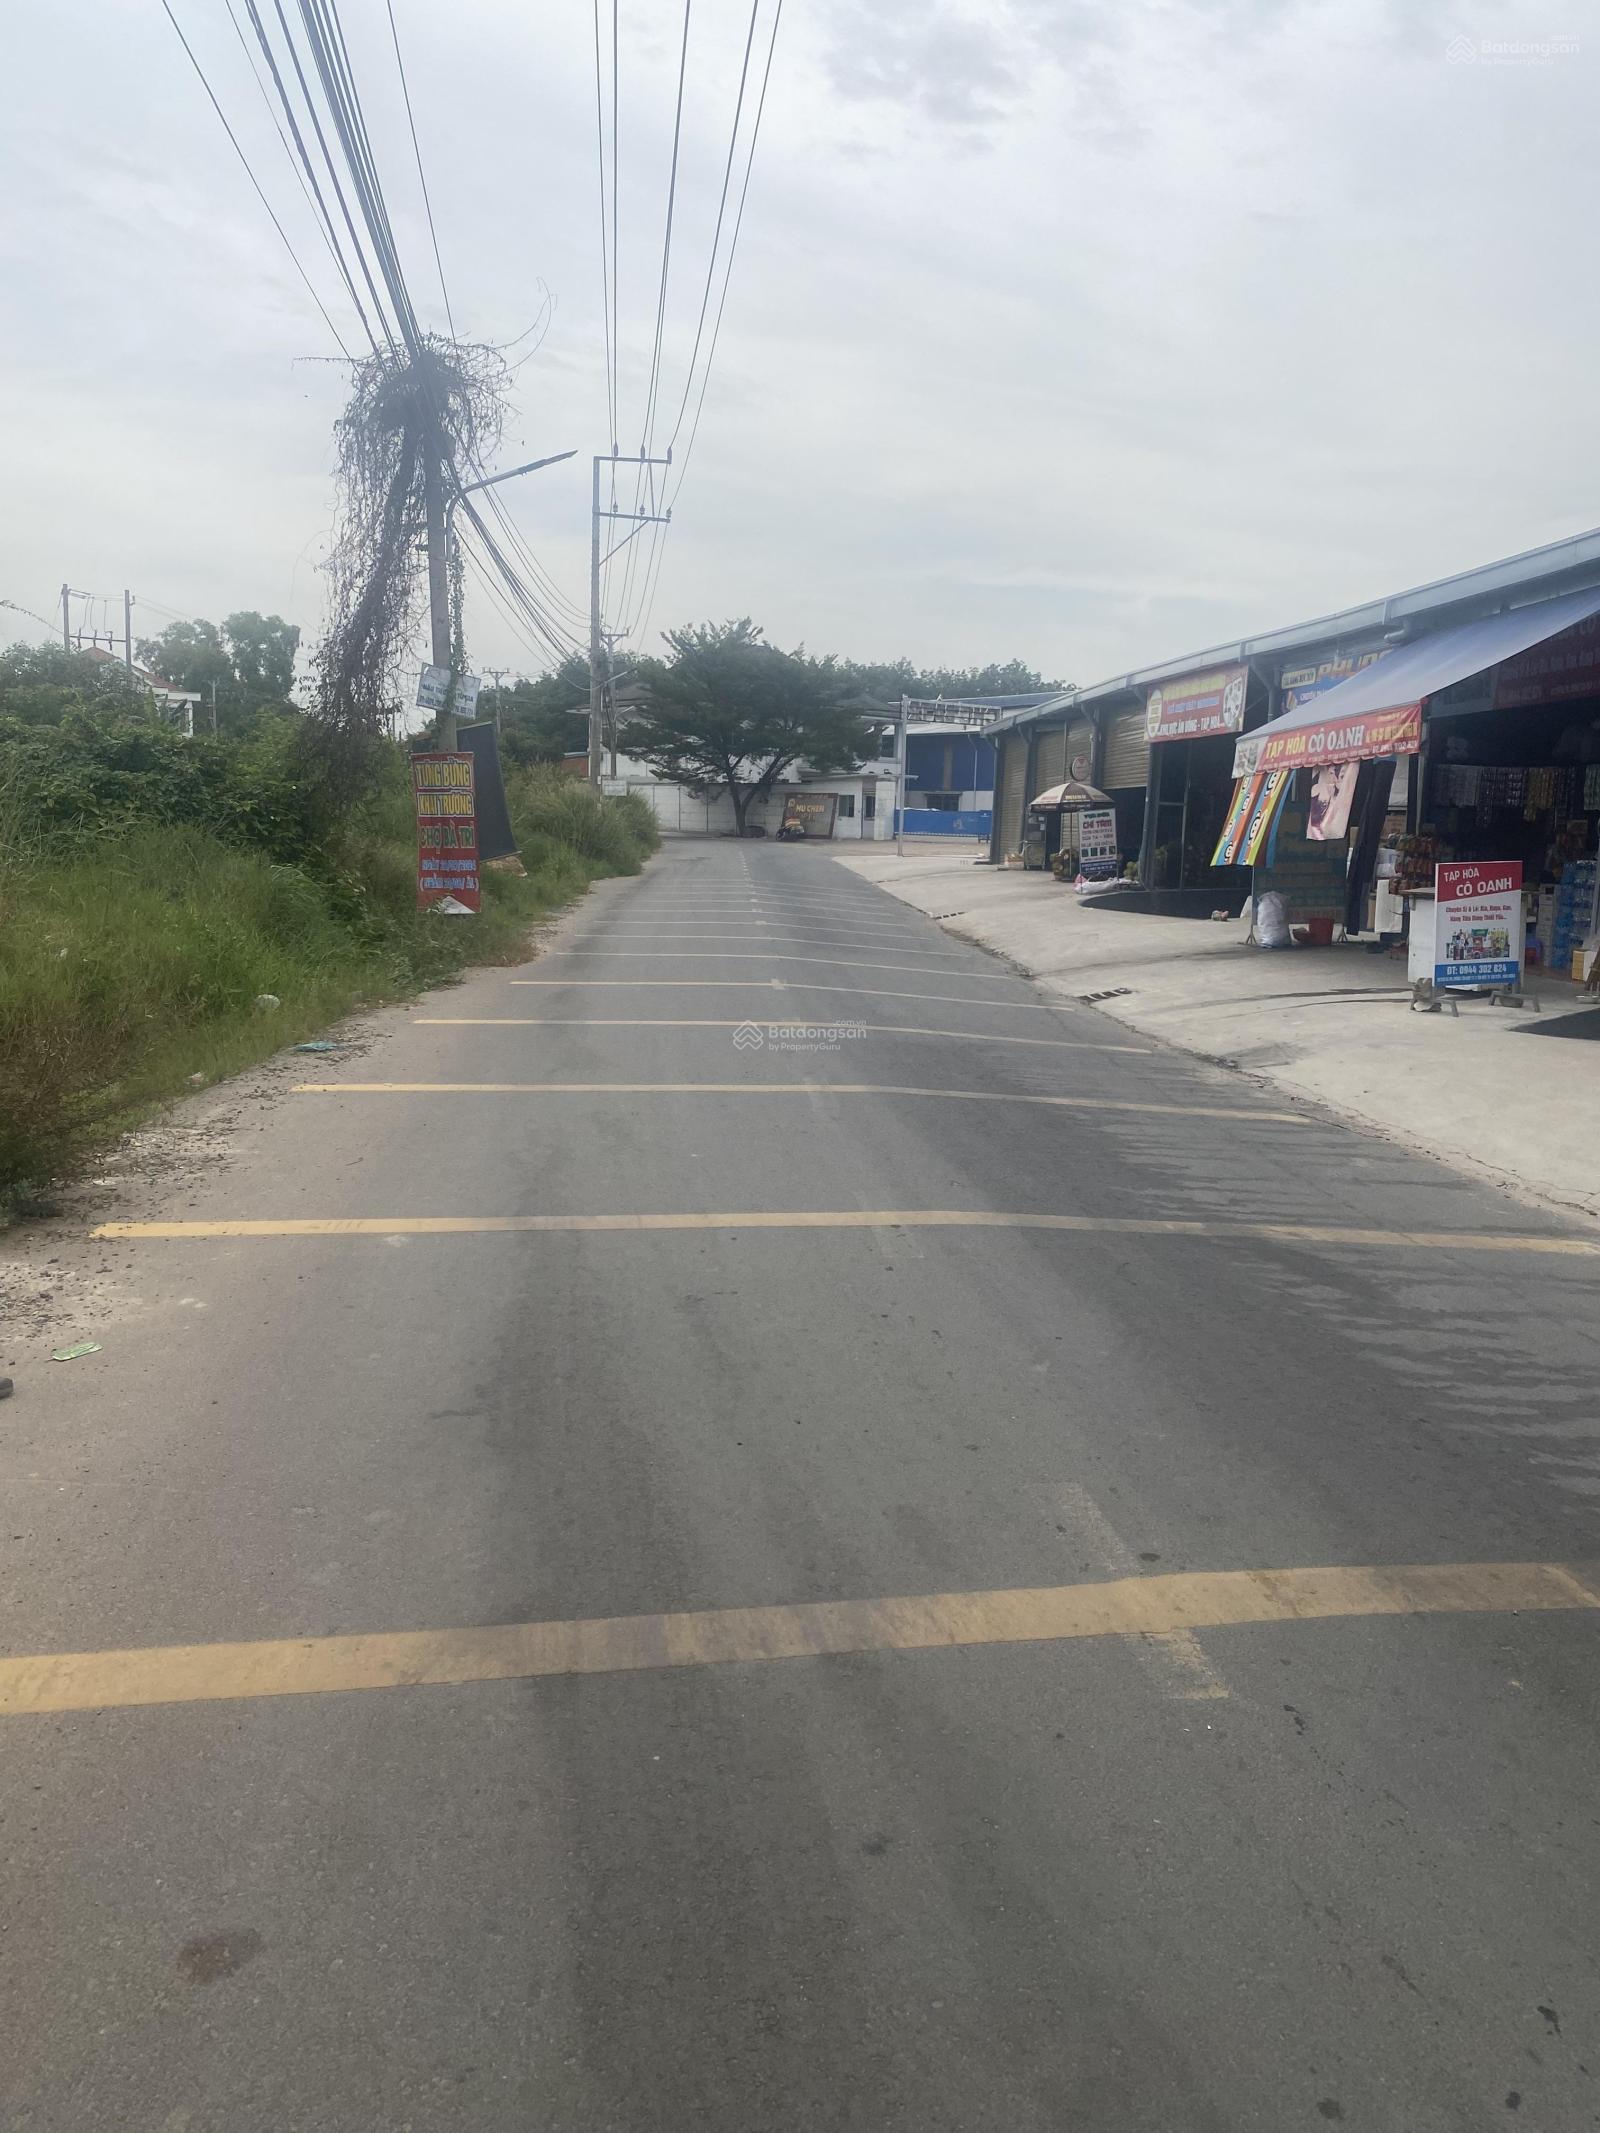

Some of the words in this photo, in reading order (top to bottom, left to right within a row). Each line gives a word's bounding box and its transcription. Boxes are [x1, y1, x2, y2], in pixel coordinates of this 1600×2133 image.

[1265, 740, 1284, 762] TẠP
[1286, 733, 1306, 755] HÓA
[1308, 728, 1325, 753] CÔ
[1327, 725, 1365, 751] OANH
[1444, 871, 1460, 884] TẠP
[1462, 866, 1479, 879] HÓA
[1456, 881, 1473, 896] CÔ
[1477, 877, 1512, 893] OANH
